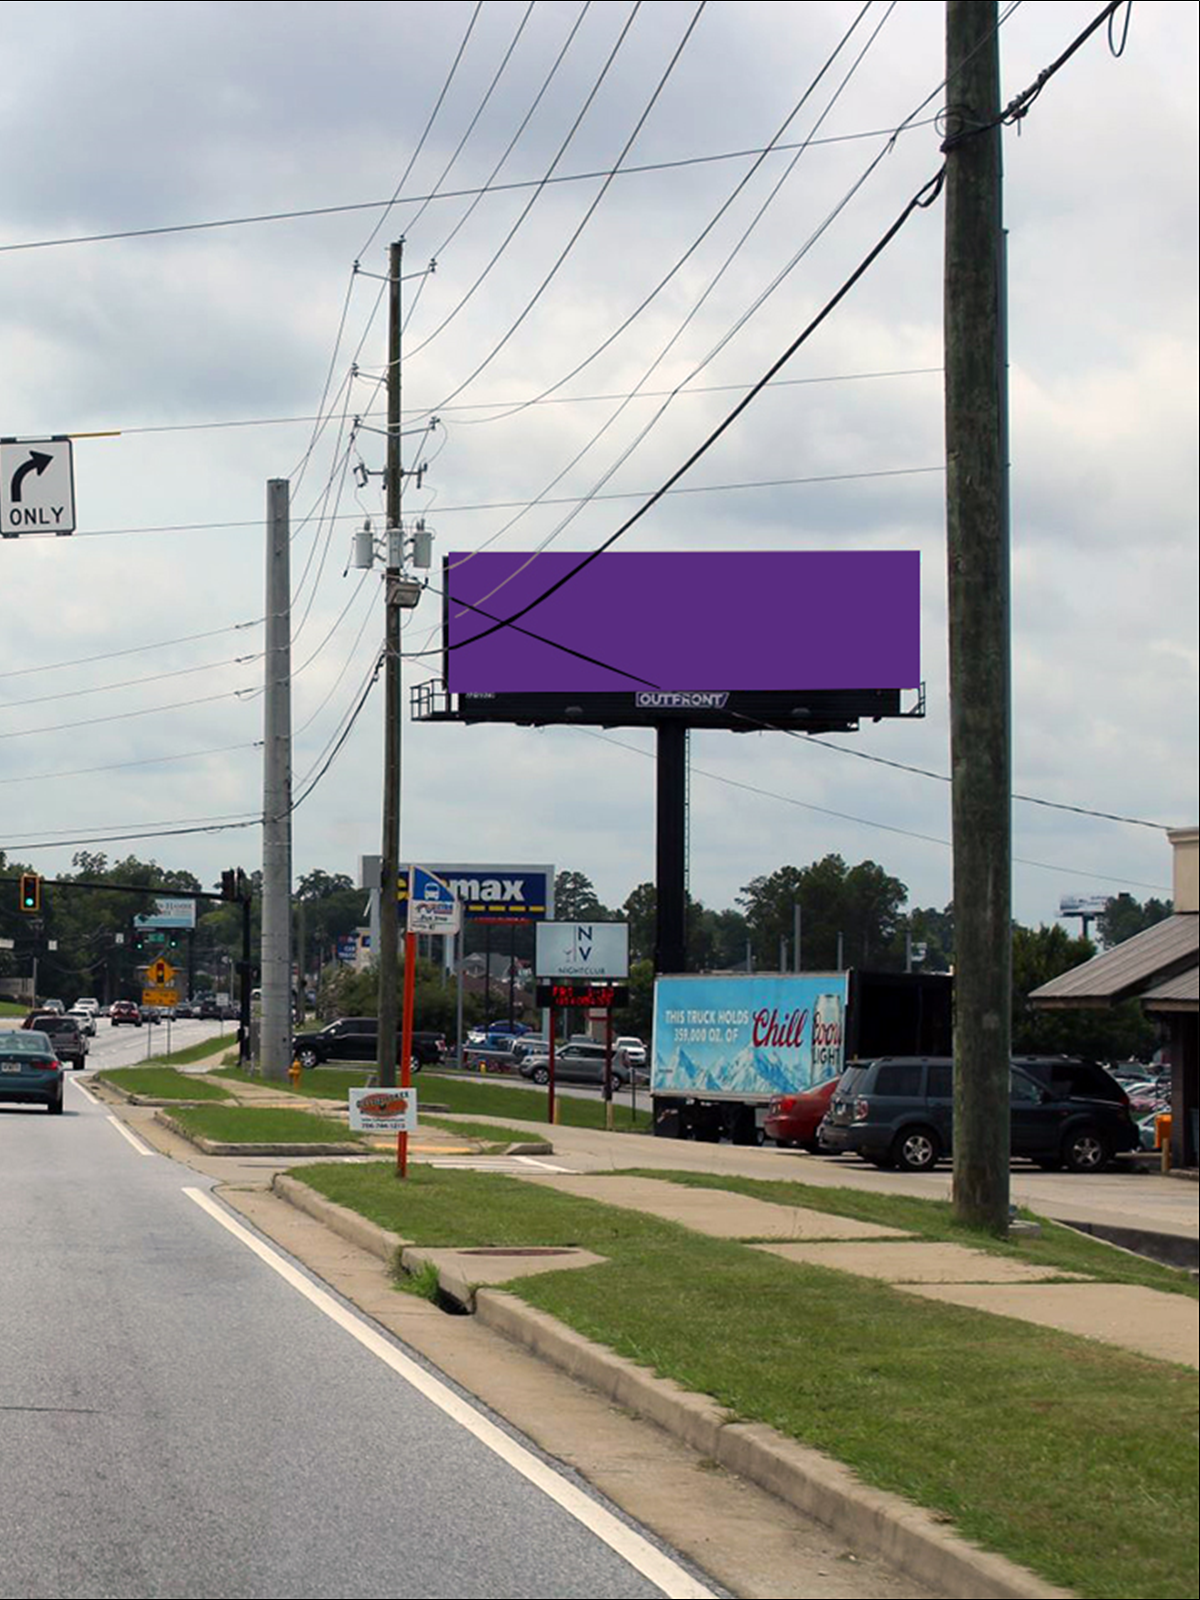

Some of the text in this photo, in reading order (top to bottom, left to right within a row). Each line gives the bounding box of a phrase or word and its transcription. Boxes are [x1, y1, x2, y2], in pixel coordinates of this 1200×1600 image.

[9, 506, 64, 526] ONLY
[639, 692, 723, 706] OUTFRONT
[578, 925, 593, 941] N
[578, 946, 592, 962] V
[558, 966, 606, 975] NIGHTCLUB
[665, 1007, 809, 1048] THIS TRUCK HOLDS Chill
[726, 1027, 740, 1042] OF
